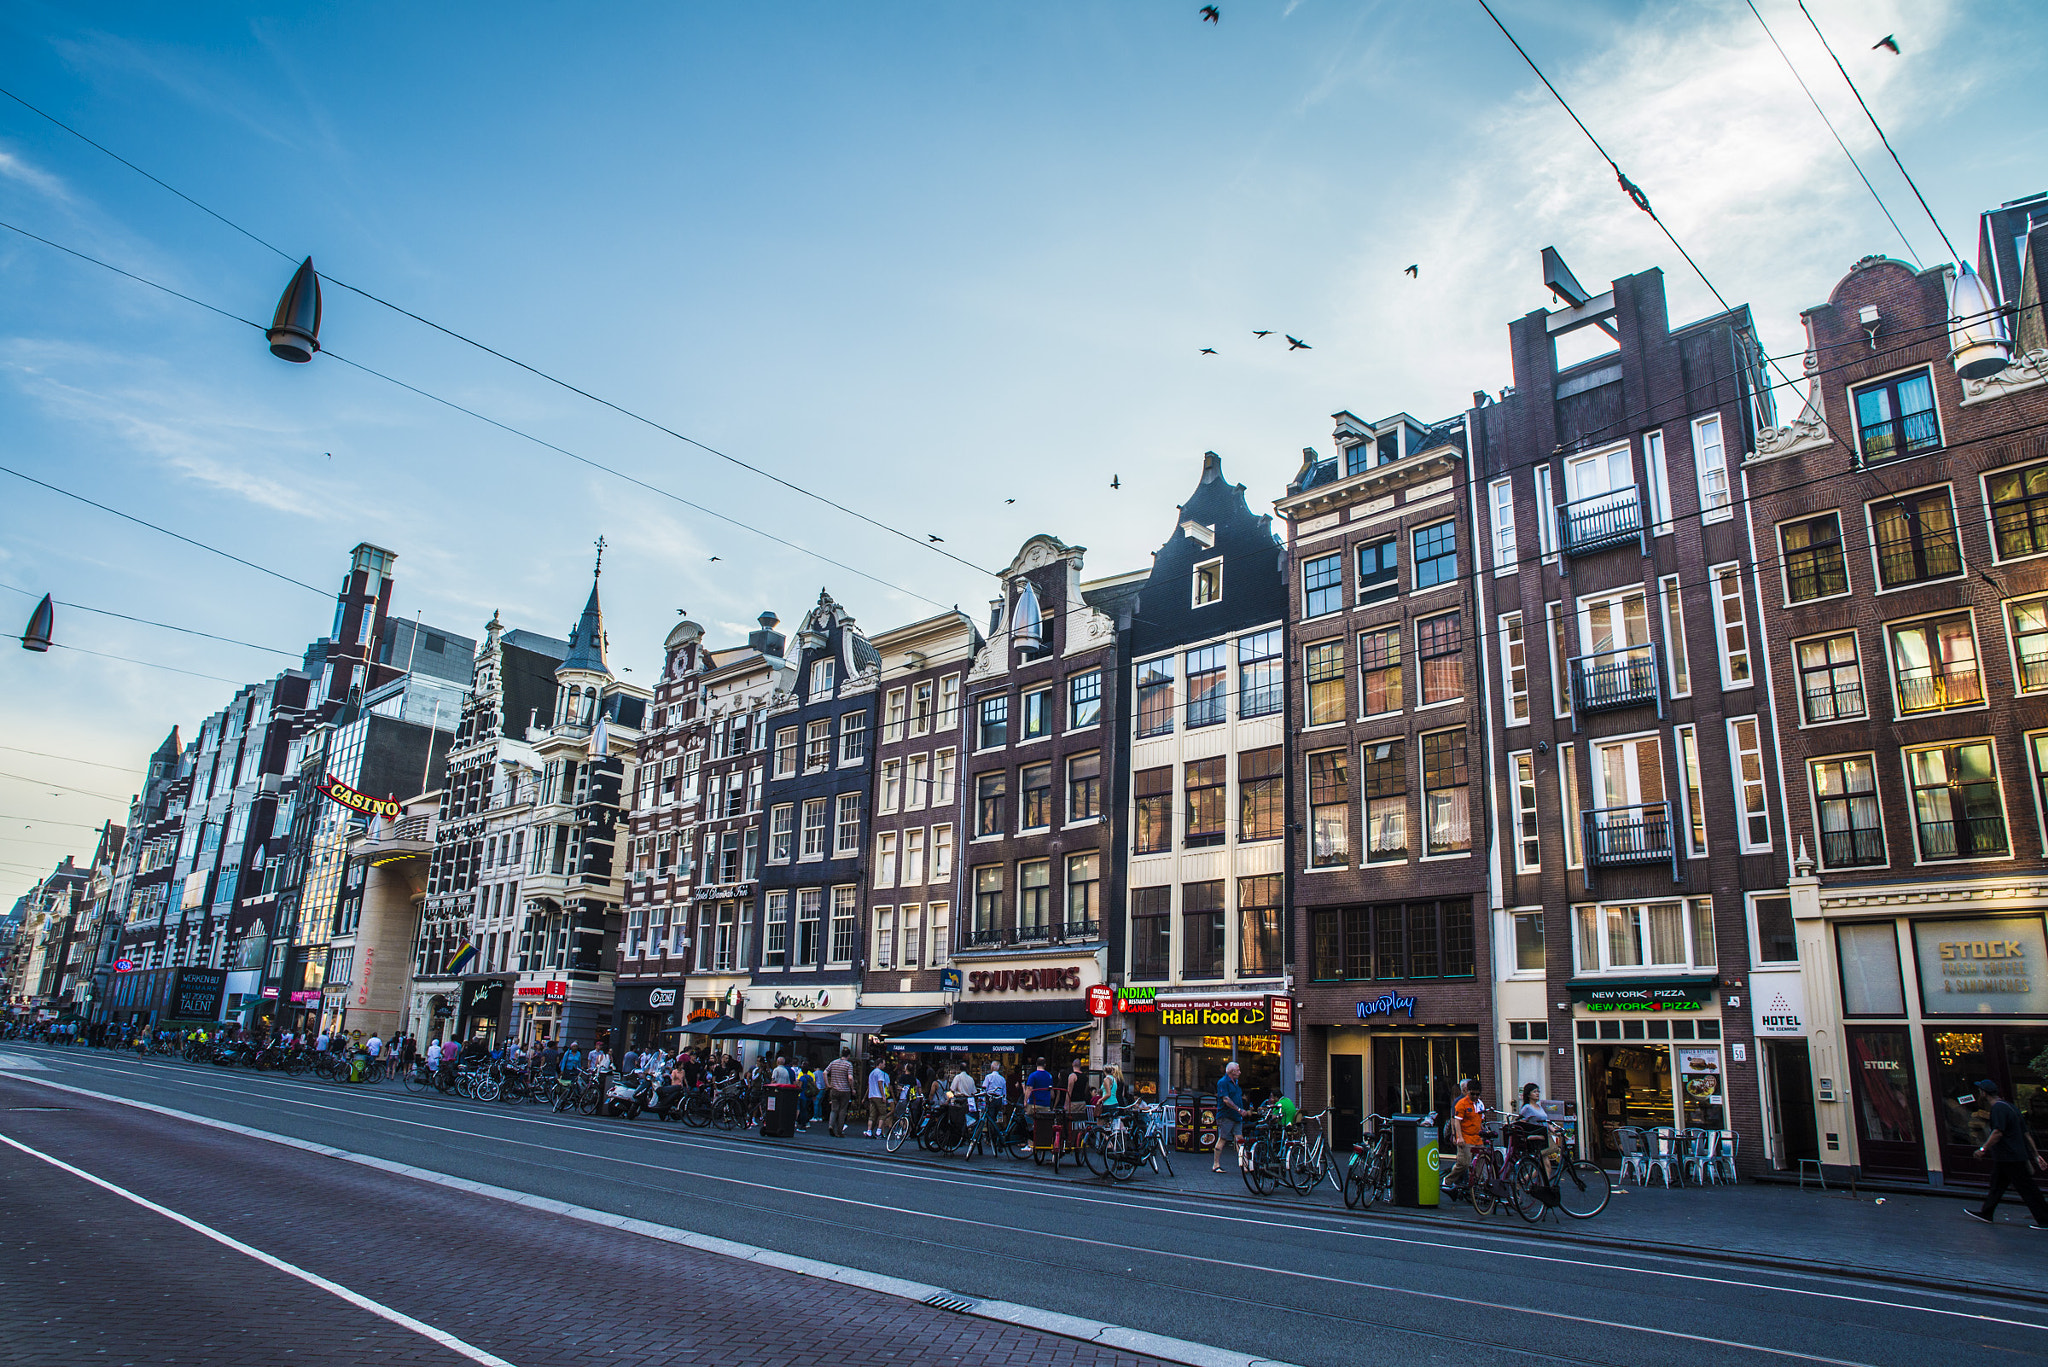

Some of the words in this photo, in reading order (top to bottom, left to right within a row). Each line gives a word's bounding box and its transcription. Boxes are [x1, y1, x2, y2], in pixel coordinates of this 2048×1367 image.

[330, 783, 399, 817] CASINO
[1938, 940, 2024, 960] STOCK
[1941, 962, 1978, 976] FRESH
[1982, 961, 2026, 975] COFFEE
[358, 946, 375, 1005] CASINO
[968, 966, 1082, 992] SOUVENIRS
[180, 983, 218, 992] PRIMARK
[1093, 988, 1110, 996] INDIAN
[1944, 979, 1952, 993] &
[1955, 979, 2031, 993] SANDWICHES
[1118, 987, 1156, 999] INDIAN
[1591, 991, 1614, 999] NEW
[1615, 990, 1648, 999] YORK
[1654, 990, 1687, 998] PIZZA
[180, 999, 213, 1012] TALENT
[1128, 1004, 1155, 1013] GANDHI
[1356, 990, 1415, 1019] novoplay
[1587, 1003, 1614, 1011] NEW
[1615, 1002, 1655, 1011] YORK
[1662, 1002, 1701, 1011] PIZZA
[1162, 1009, 1198, 1025] Halal
[1203, 1008, 1239, 1025] Food
[1762, 1015, 1802, 1026] HOTEL
[1735, 1049, 1745, 1060] 50
[1863, 1060, 1900, 1070] STOCK
